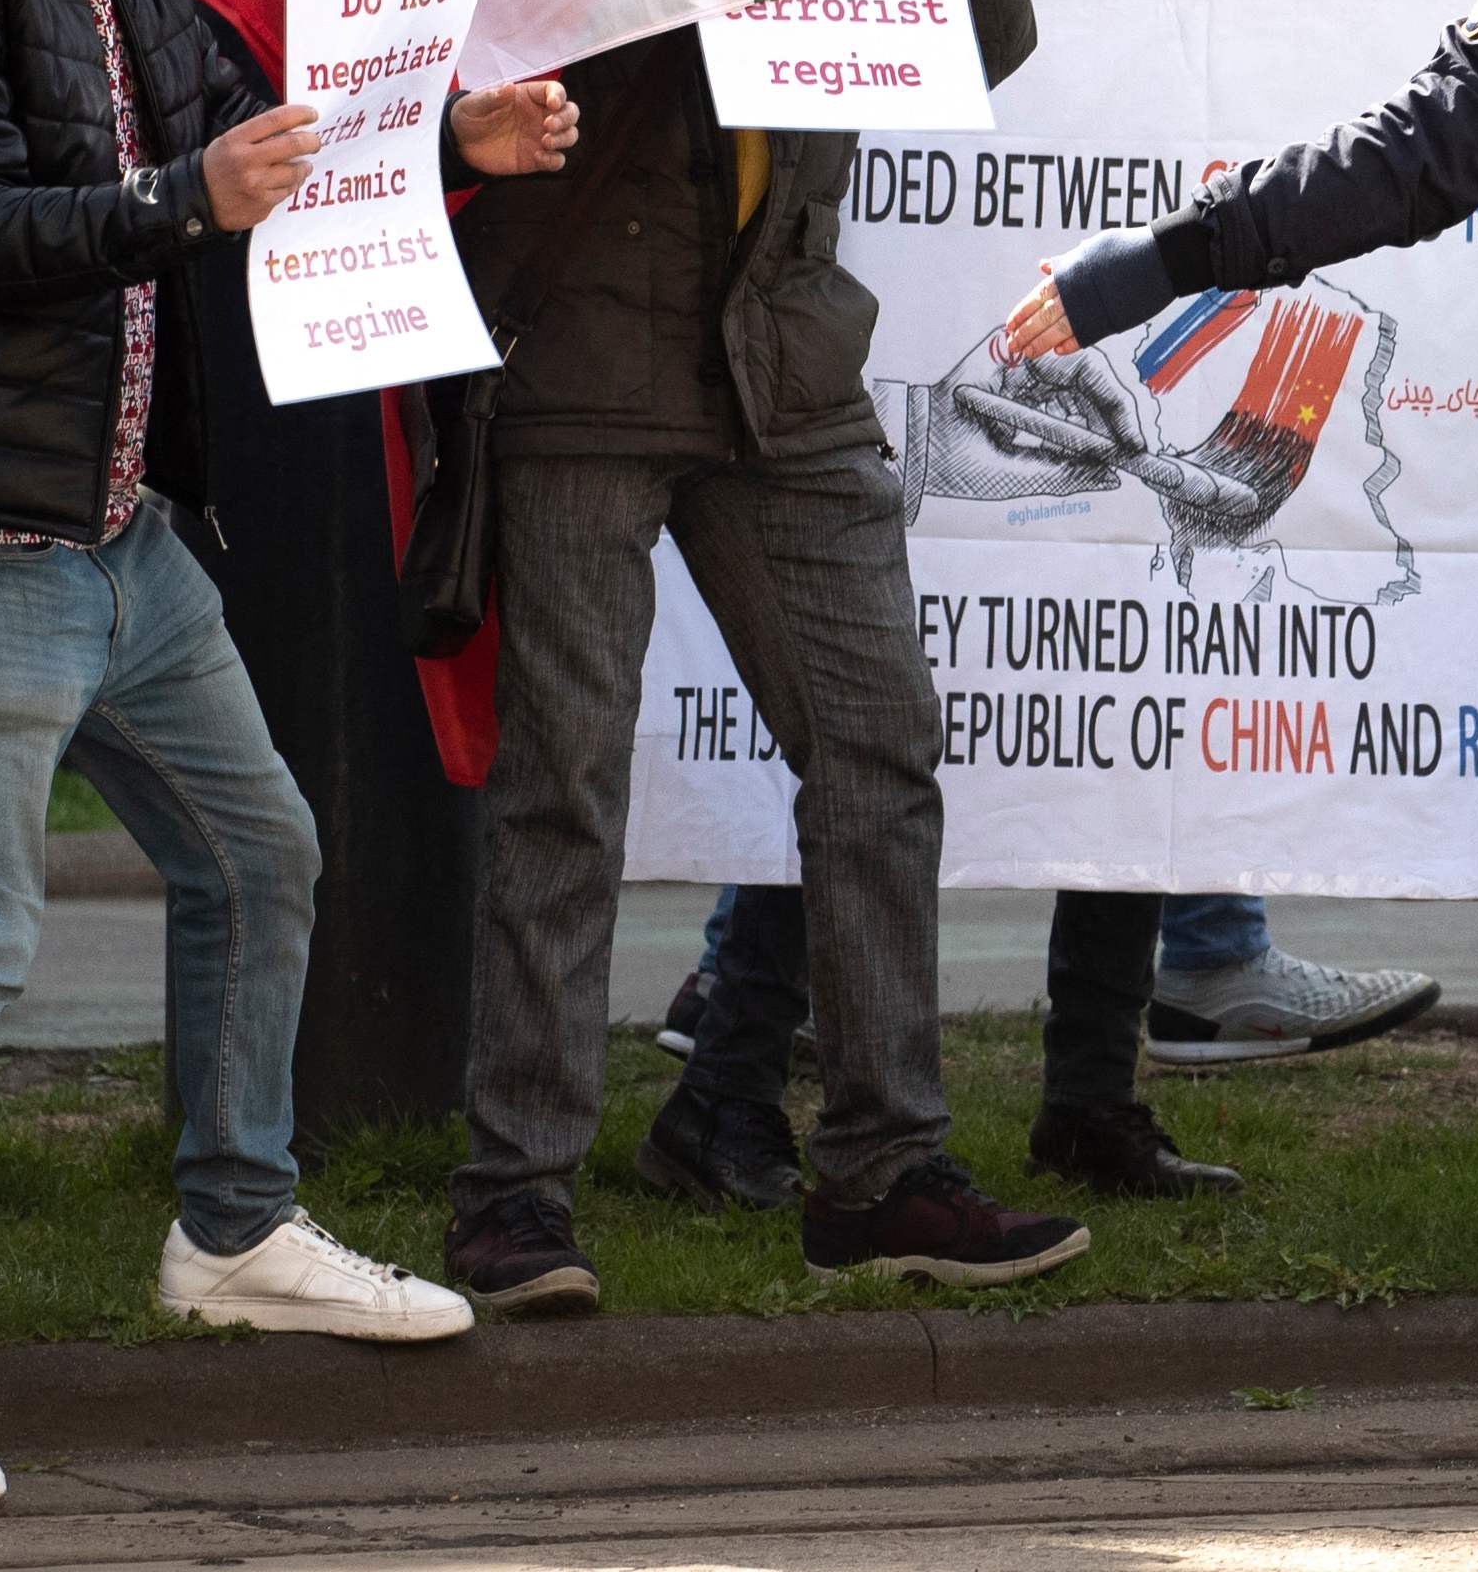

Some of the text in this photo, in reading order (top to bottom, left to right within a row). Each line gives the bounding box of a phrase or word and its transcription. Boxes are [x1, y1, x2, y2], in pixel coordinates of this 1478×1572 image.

[307, 35, 453, 96] negotiate
[768, 51, 922, 95] regime
[377, 96, 422, 132] the
[851, 148, 957, 225] IDED
[974, 152, 1182, 230] BETWEEN
[265, 228, 439, 284] terrorist
[304, 302, 430, 351] regime
[1006, 498, 1091, 526] @ghalamfarsa
[919, 595, 1377, 680] EY TURNED IRAN INTO
[674, 687, 738, 761] THE
[944, 692, 1116, 771] EPUBLIC
[1131, 697, 1187, 772] OF
[1200, 699, 1335, 774] CHINA
[1349, 703, 1443, 776] AND
